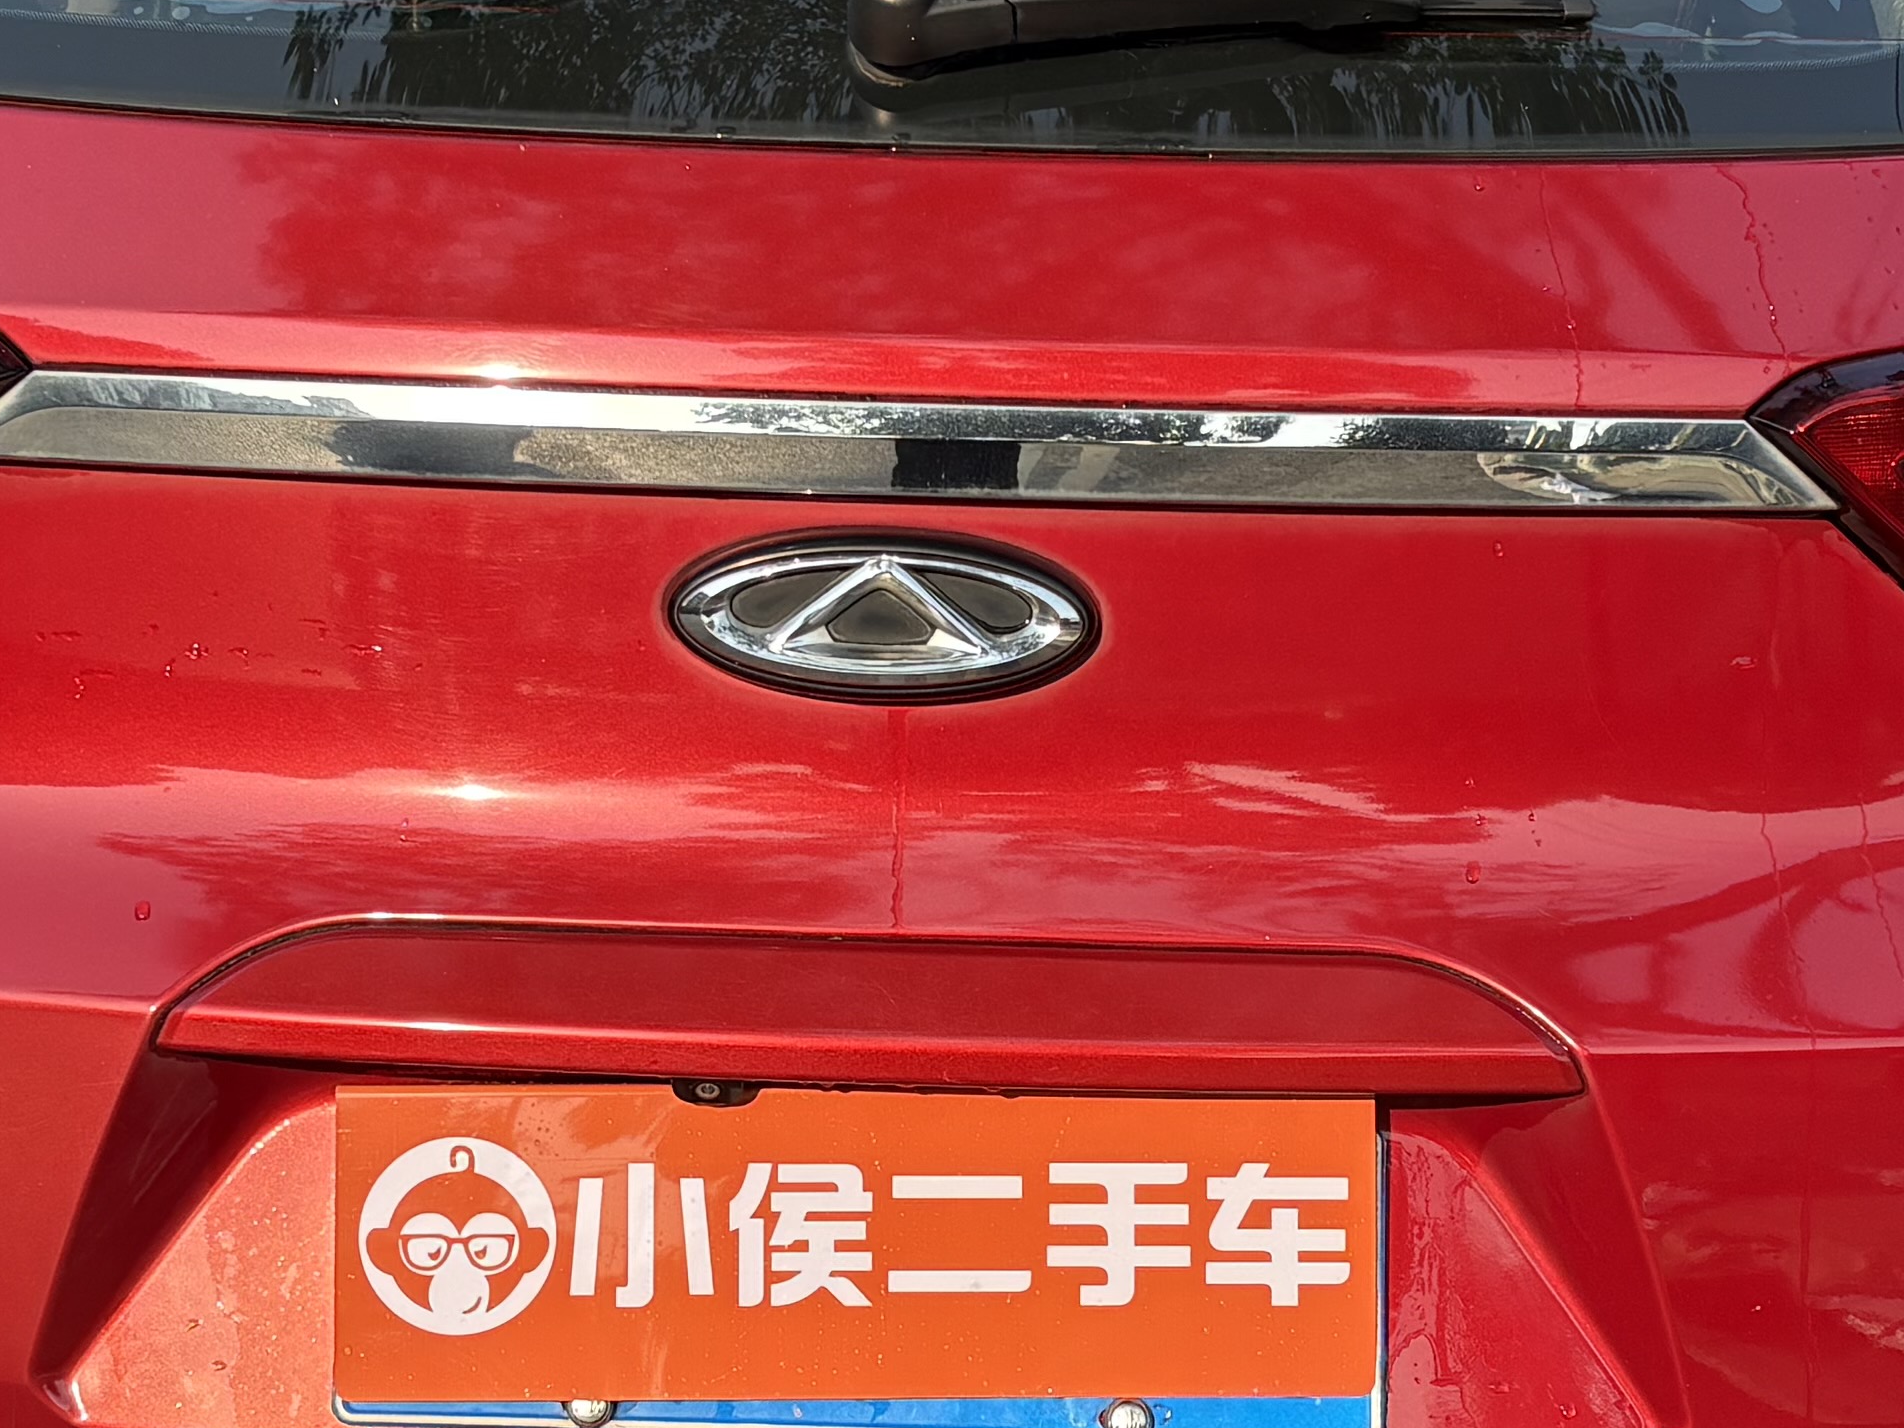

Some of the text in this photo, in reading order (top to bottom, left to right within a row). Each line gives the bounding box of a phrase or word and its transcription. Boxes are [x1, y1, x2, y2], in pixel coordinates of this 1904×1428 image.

[569, 1162, 1351, 1307] 小侯二手车
